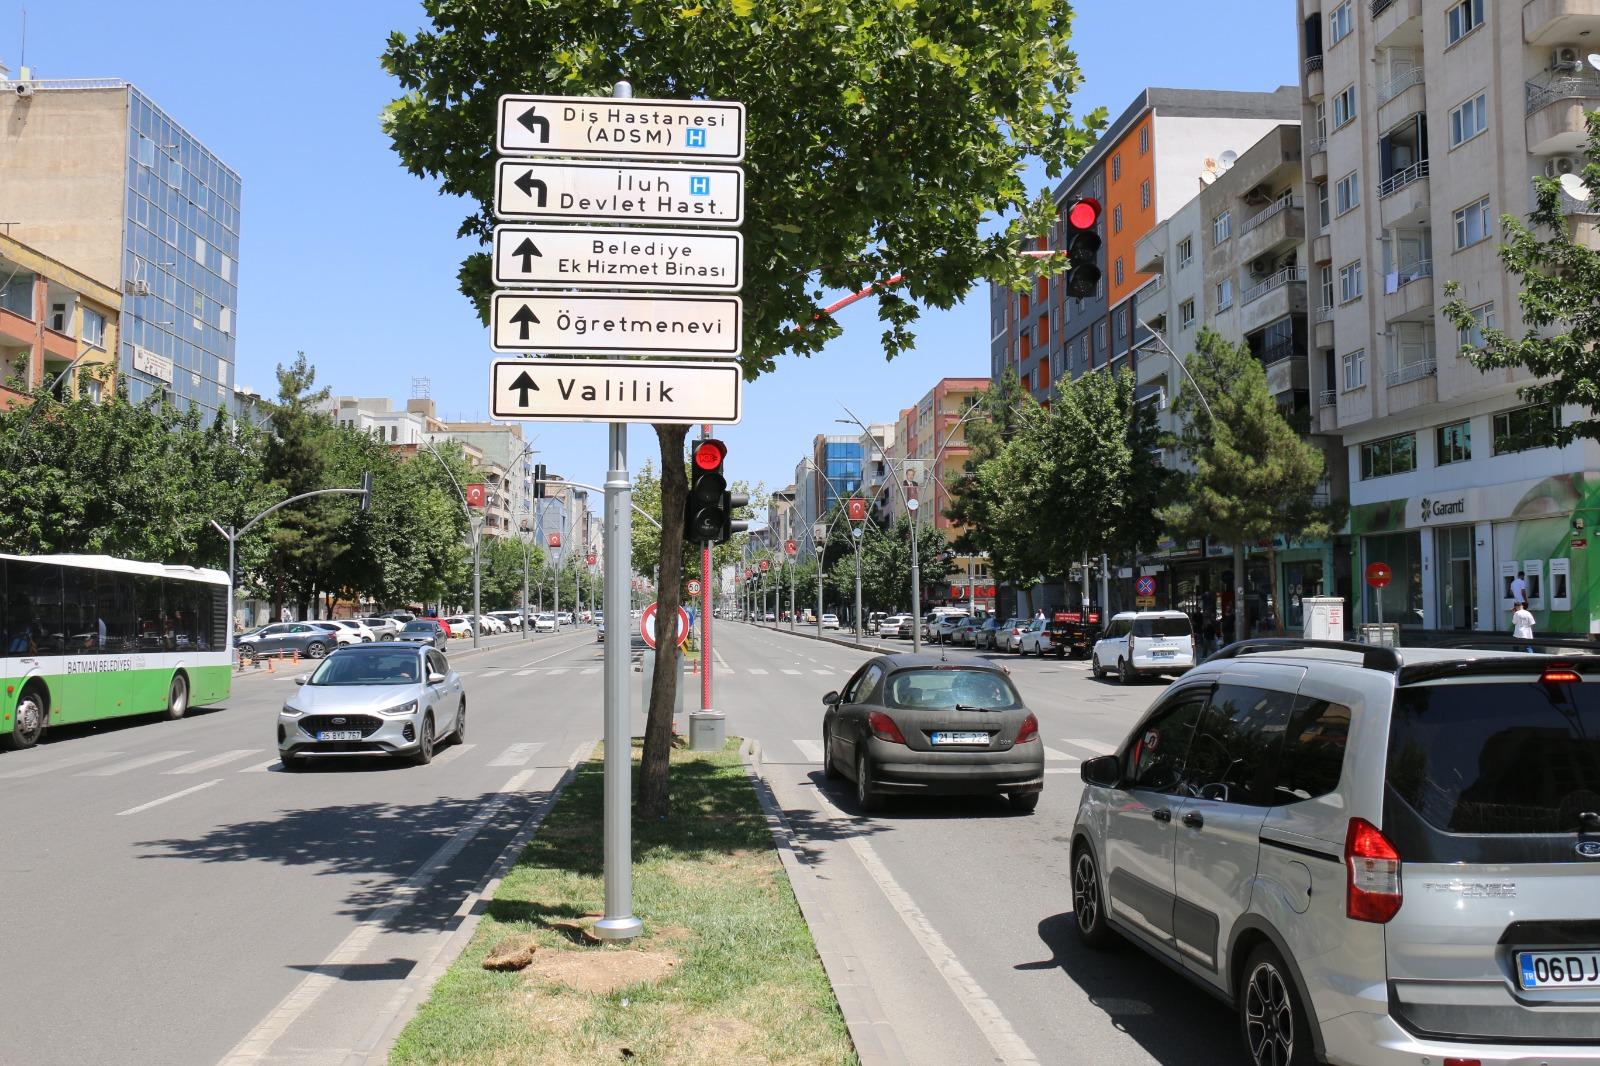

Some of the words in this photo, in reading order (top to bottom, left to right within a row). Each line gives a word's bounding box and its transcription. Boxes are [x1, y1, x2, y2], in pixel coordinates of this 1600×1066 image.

[563, 107, 599, 124] Diş
[608, 109, 725, 127] Hastanesi
[587, 126, 672, 146] (ADSM)
[617, 170, 669, 193] İluh
[560, 193, 646, 212] Devlet
[658, 196, 723, 215] Hast.
[592, 240, 692, 260] Belediye
[558, 258, 581, 273] Ek
[587, 259, 658, 275] Hizmet
[666, 261, 725, 277] Binası
[556, 309, 721, 334] Öğretmenevi
[557, 378, 673, 402] Valilik
[1432, 498, 1464, 516] Garanti
[689, 583, 699, 592] 50
[67, 660, 98, 674] BATMAN
[1523, 972, 1534, 981] TR
